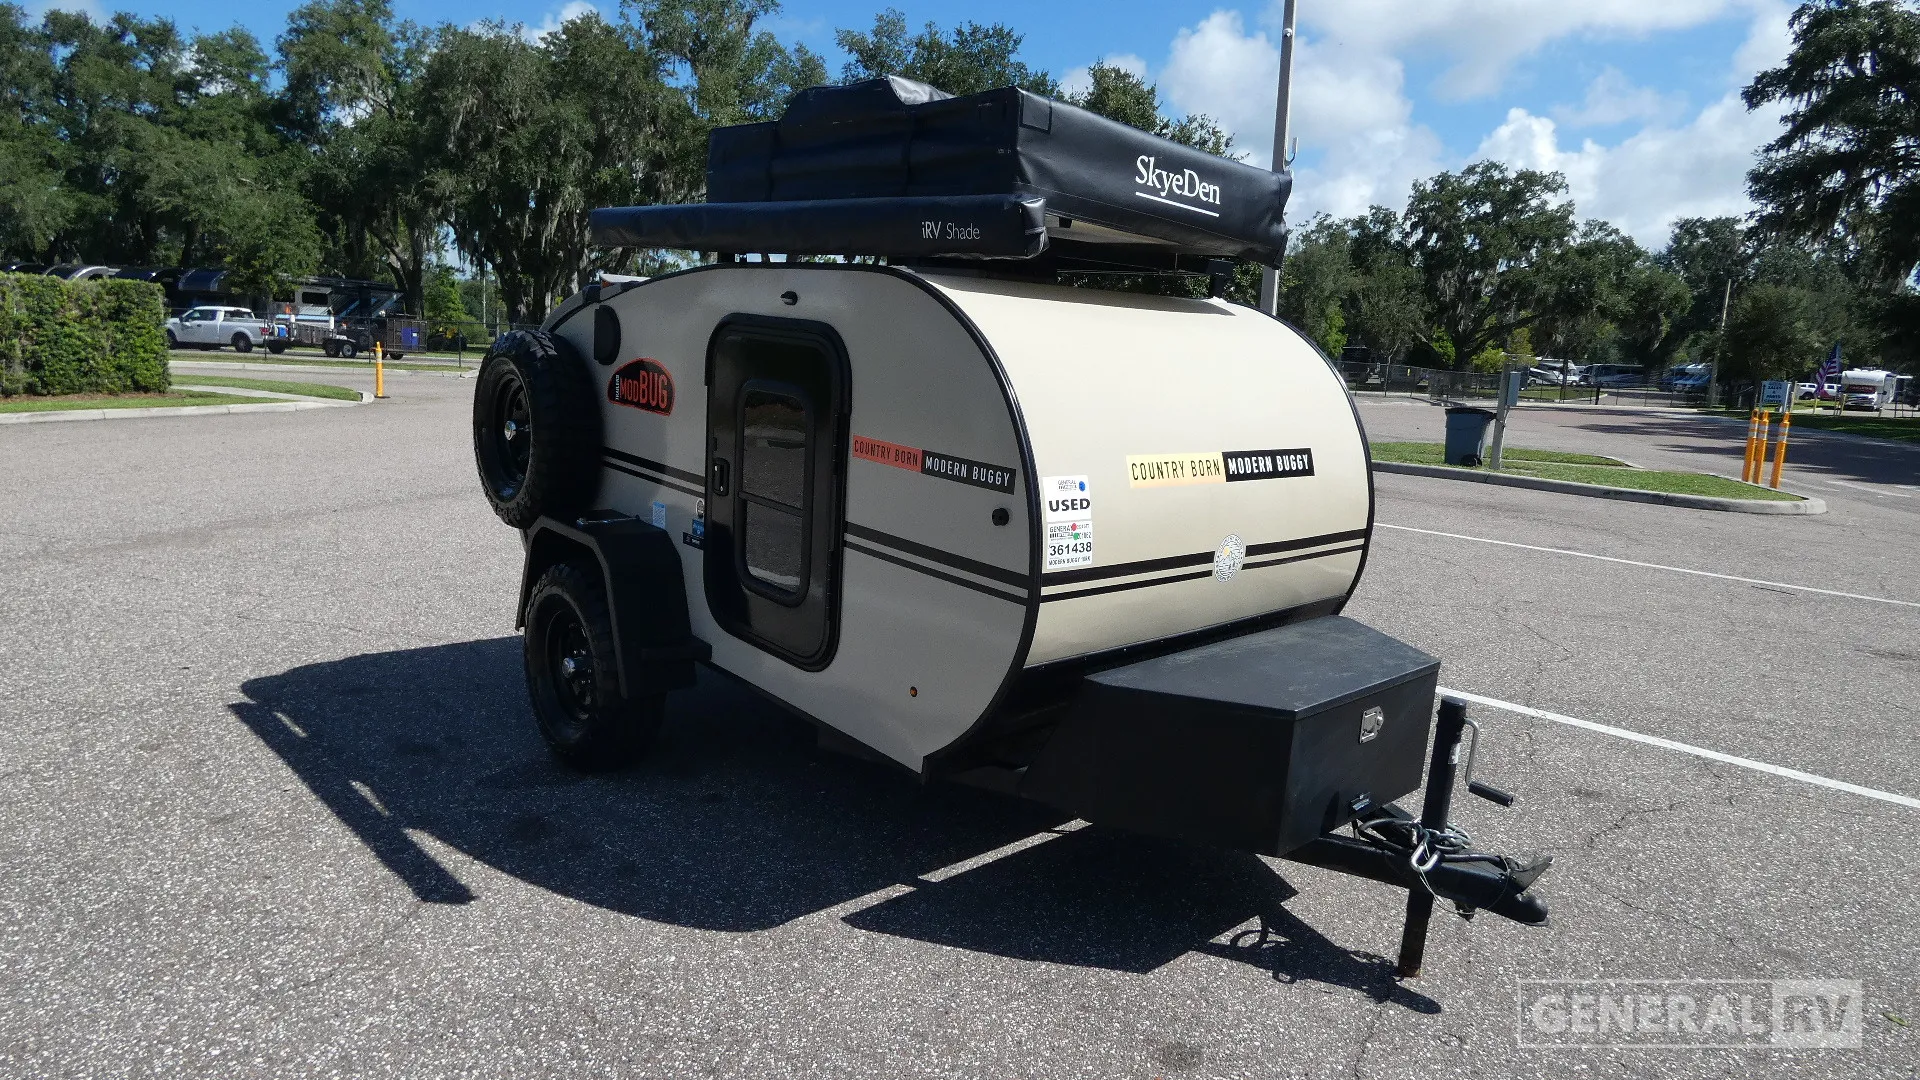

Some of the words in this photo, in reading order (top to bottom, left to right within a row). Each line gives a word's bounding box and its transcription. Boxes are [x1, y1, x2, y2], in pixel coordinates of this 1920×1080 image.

[1135, 155, 1221, 205] SkyeDen
[921, 221, 941, 240] iRV
[946, 222, 980, 240] Shade
[854, 439, 892, 460] COUNTRY
[894, 450, 918, 466] BORN
[925, 455, 967, 478] MODERN
[972, 466, 1010, 487] BUGGY
[1131, 460, 1185, 481] COUNTRY
[1190, 458, 1221, 477] BORN
[1227, 455, 1273, 475] MODERN
[1276, 454, 1309, 471] BUGGY
[1048, 498, 1091, 512] USED
[1049, 541, 1092, 556] 361438
